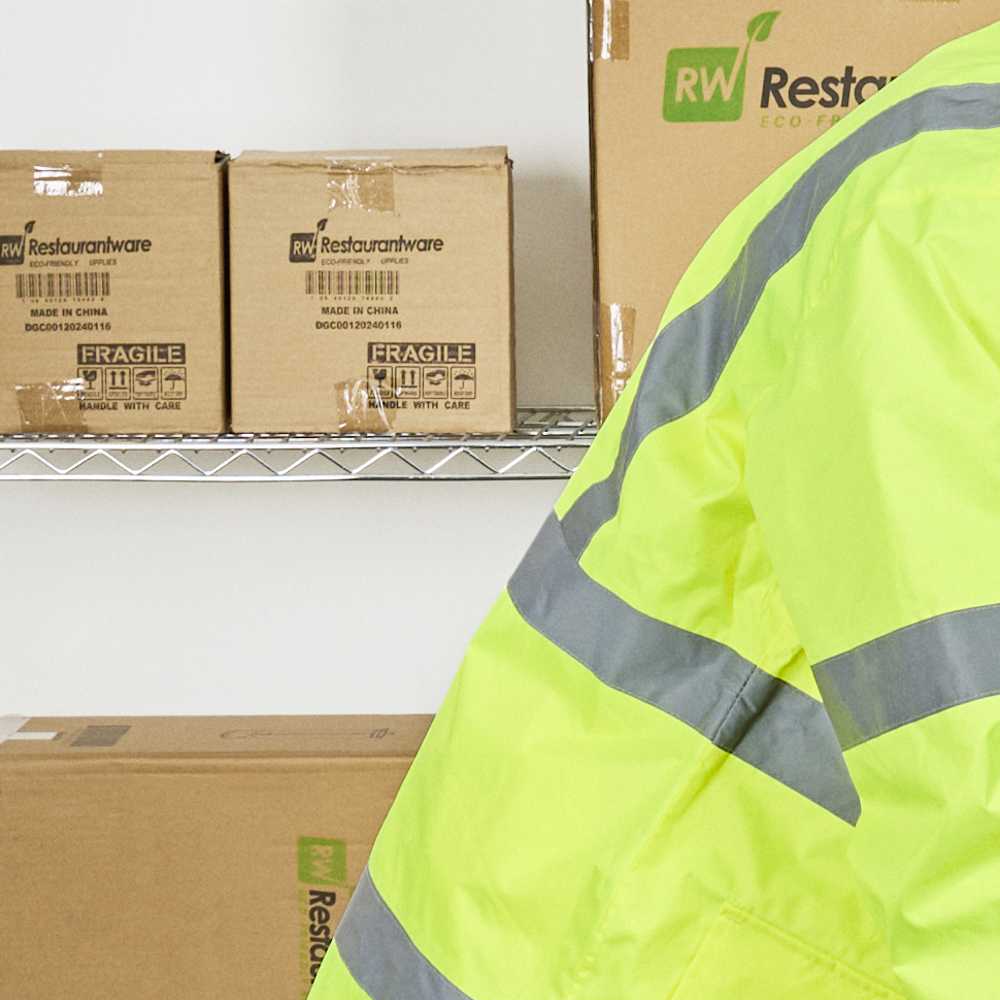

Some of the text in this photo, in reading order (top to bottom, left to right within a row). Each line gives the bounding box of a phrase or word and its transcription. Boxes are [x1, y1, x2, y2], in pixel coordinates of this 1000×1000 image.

[675, 66, 738, 103] RW
[760, 66, 897, 108] Resta
[28, 235, 152, 256] Restaurantware
[320, 235, 444, 254] Restaurantware
[30, 308, 108, 317] MADE IN CHINA
[321, 306, 398, 315] MADE IN CHINA
[82, 345, 182, 363] FRAGILE
[372, 344, 472, 362] FRAGILE
[79, 401, 182, 411] HANDLE WITH CARE
[413, 401, 439, 409] WITH
[444, 401, 471, 410] CARE
